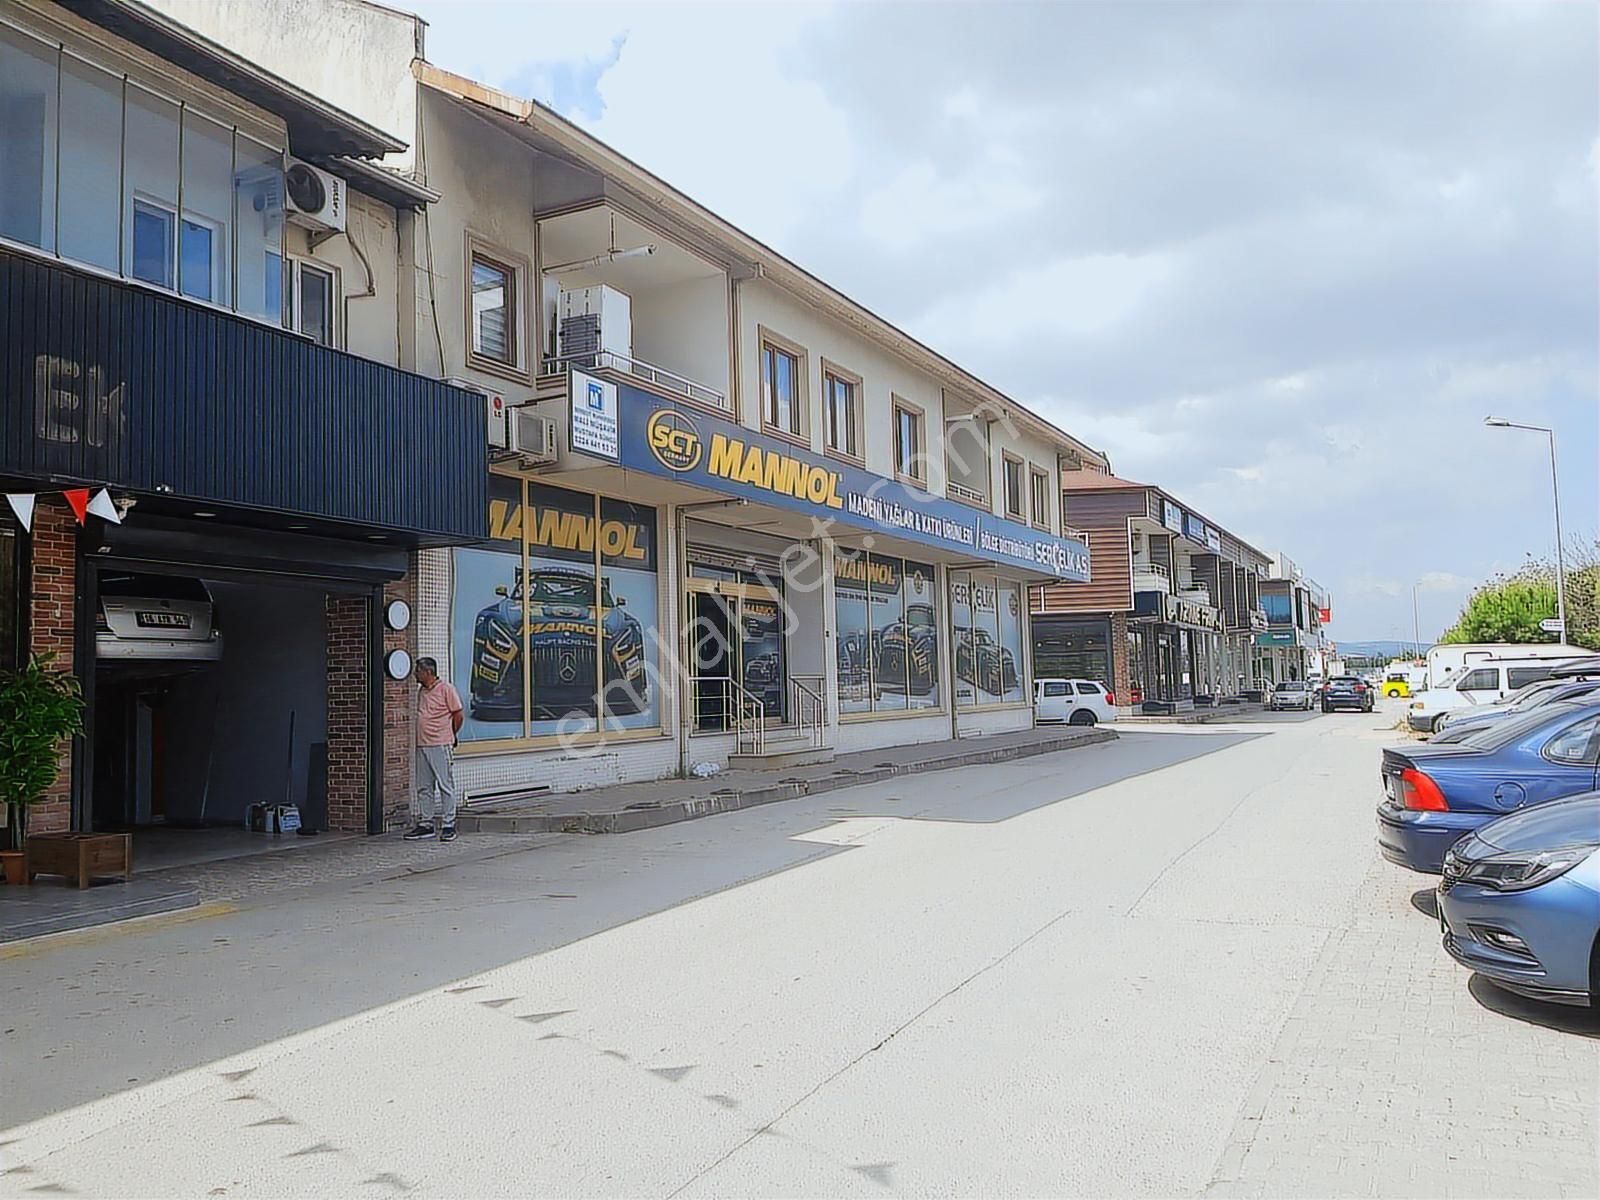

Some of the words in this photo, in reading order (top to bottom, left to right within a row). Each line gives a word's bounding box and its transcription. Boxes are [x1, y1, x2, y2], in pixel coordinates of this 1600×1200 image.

[653, 424, 699, 458] SCT
[708, 433, 843, 509] MANNOL
[848, 491, 882, 521] MADENİ
[884, 502, 914, 530] YAĞLAR
